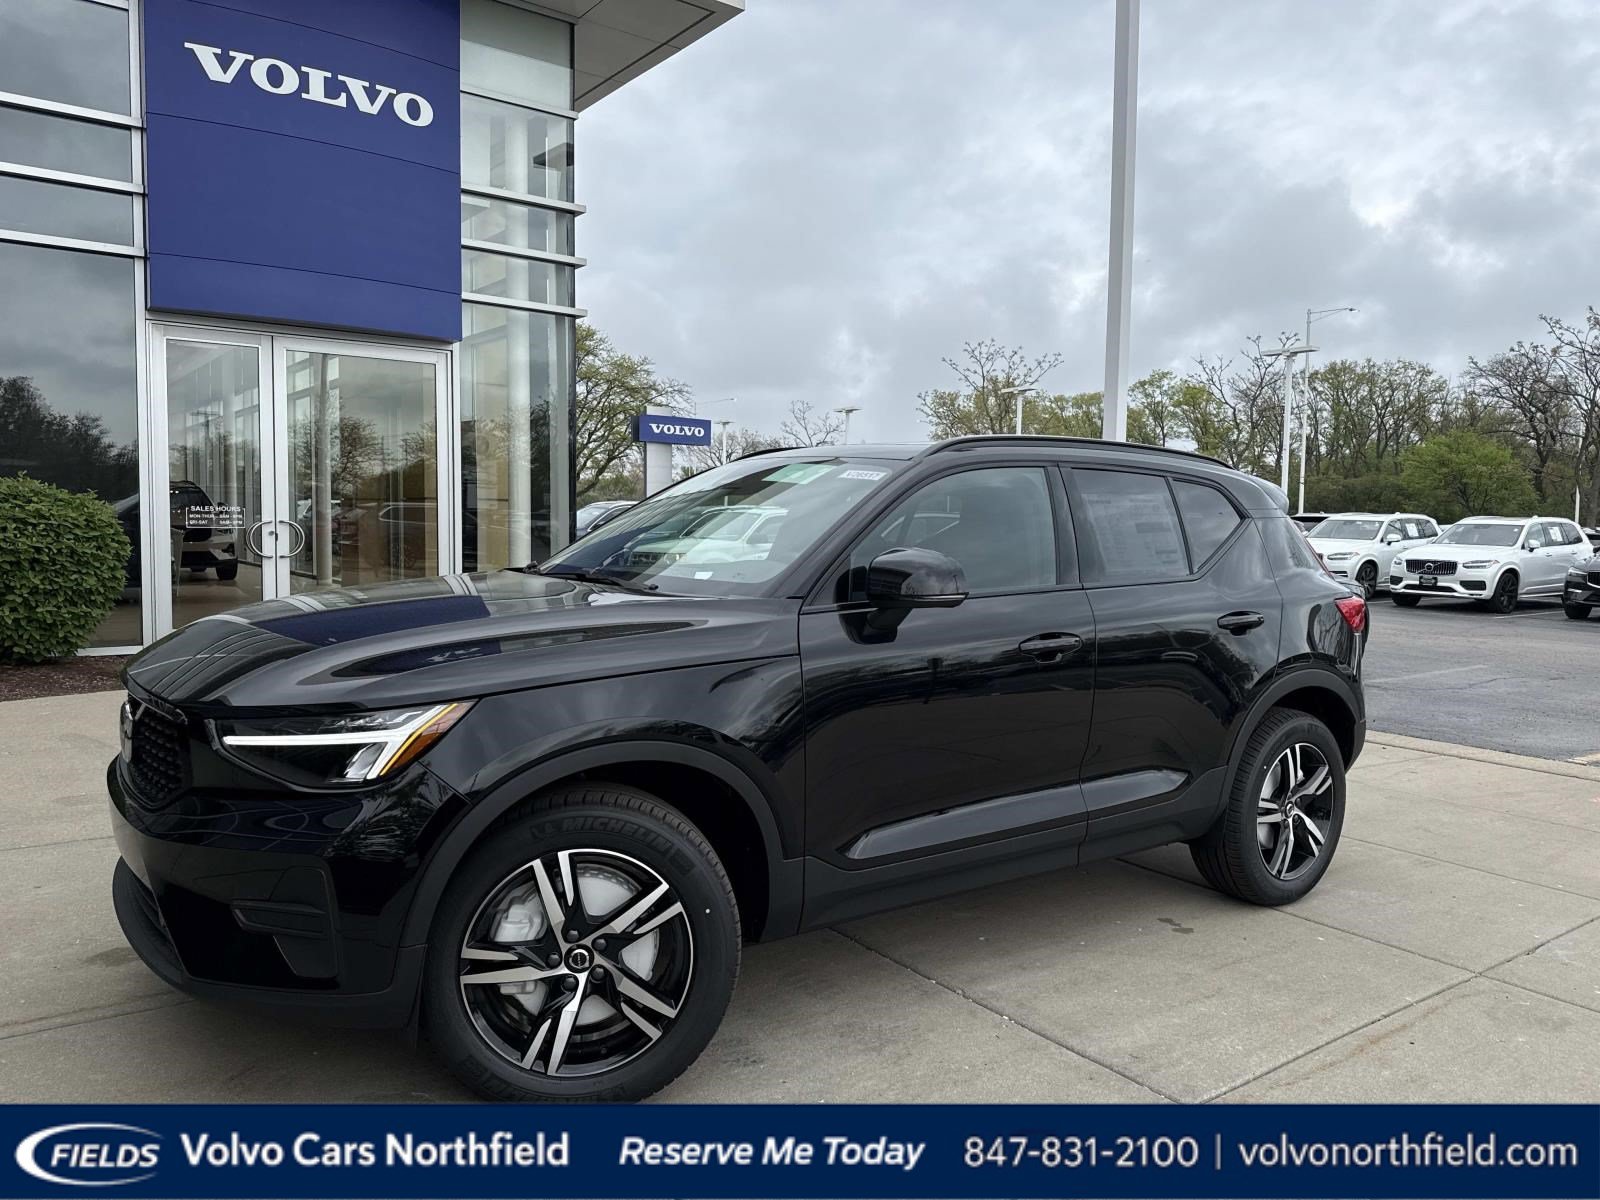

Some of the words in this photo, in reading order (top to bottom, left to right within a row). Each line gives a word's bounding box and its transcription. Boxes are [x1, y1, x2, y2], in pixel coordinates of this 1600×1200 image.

[184, 42, 434, 127] VOLVO
[649, 423, 705, 437] VOLVO
[561, 816, 673, 852] MICHELIN
